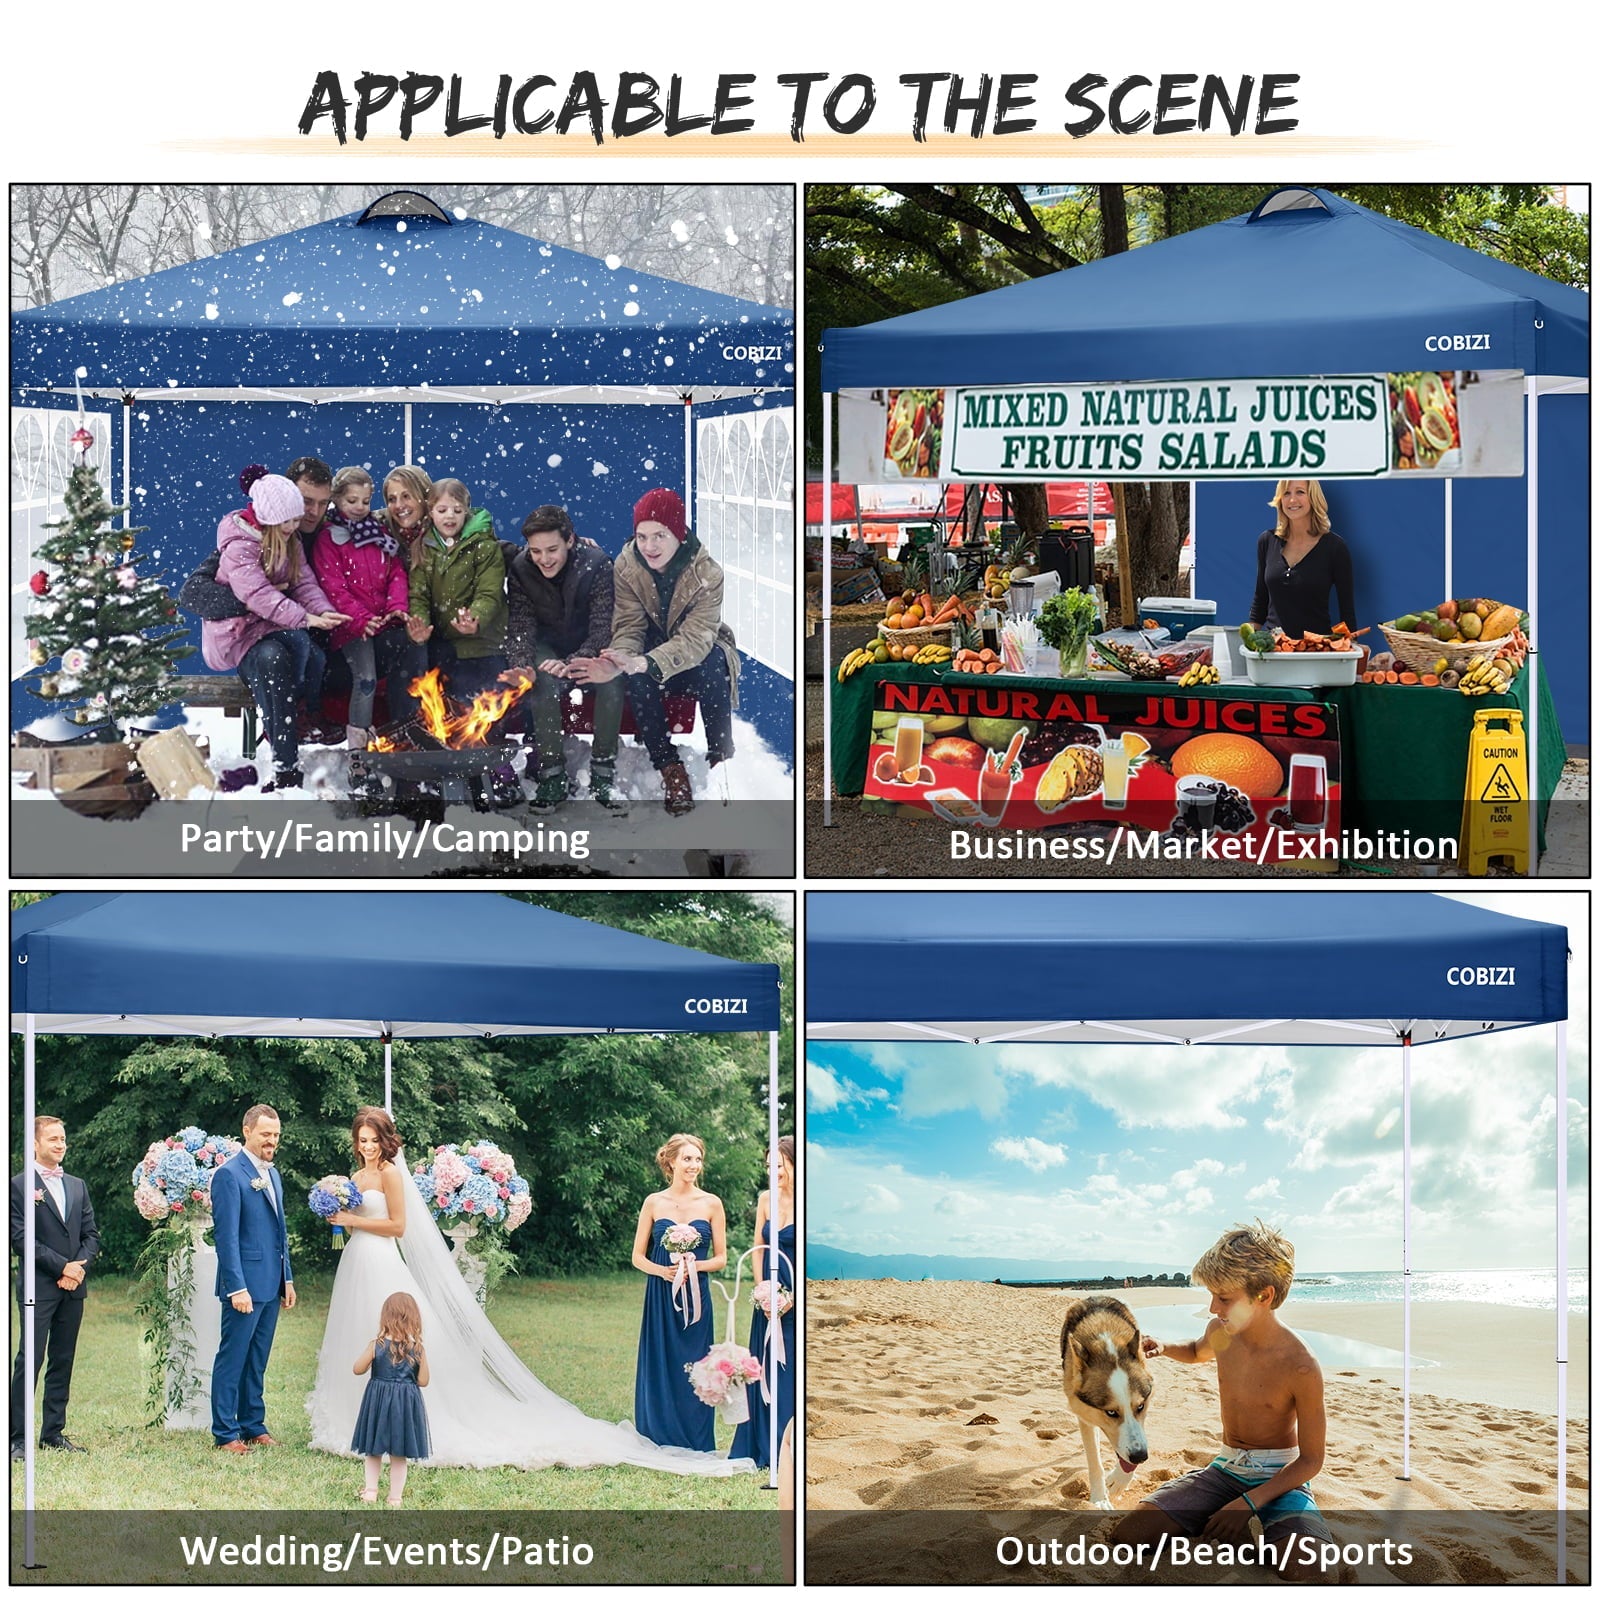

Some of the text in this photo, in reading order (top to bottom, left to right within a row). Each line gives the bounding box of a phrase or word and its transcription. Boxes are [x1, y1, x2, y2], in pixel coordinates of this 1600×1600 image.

[1424, 333, 1492, 352] COBIZI
[722, 345, 782, 361] COBIZI
[962, 383, 1378, 429] MIXED NATURAL JUICES
[1000, 428, 1327, 471] FRUITS SALADS
[884, 683, 1327, 737] NATURAL JUICES
[1483, 748, 1518, 758] CAUTION
[1489, 814, 1513, 823] FLOOR
[1493, 806, 1509, 814] WET
[1446, 967, 1516, 987] COBIZI
[683, 998, 749, 1015] COBIZI
